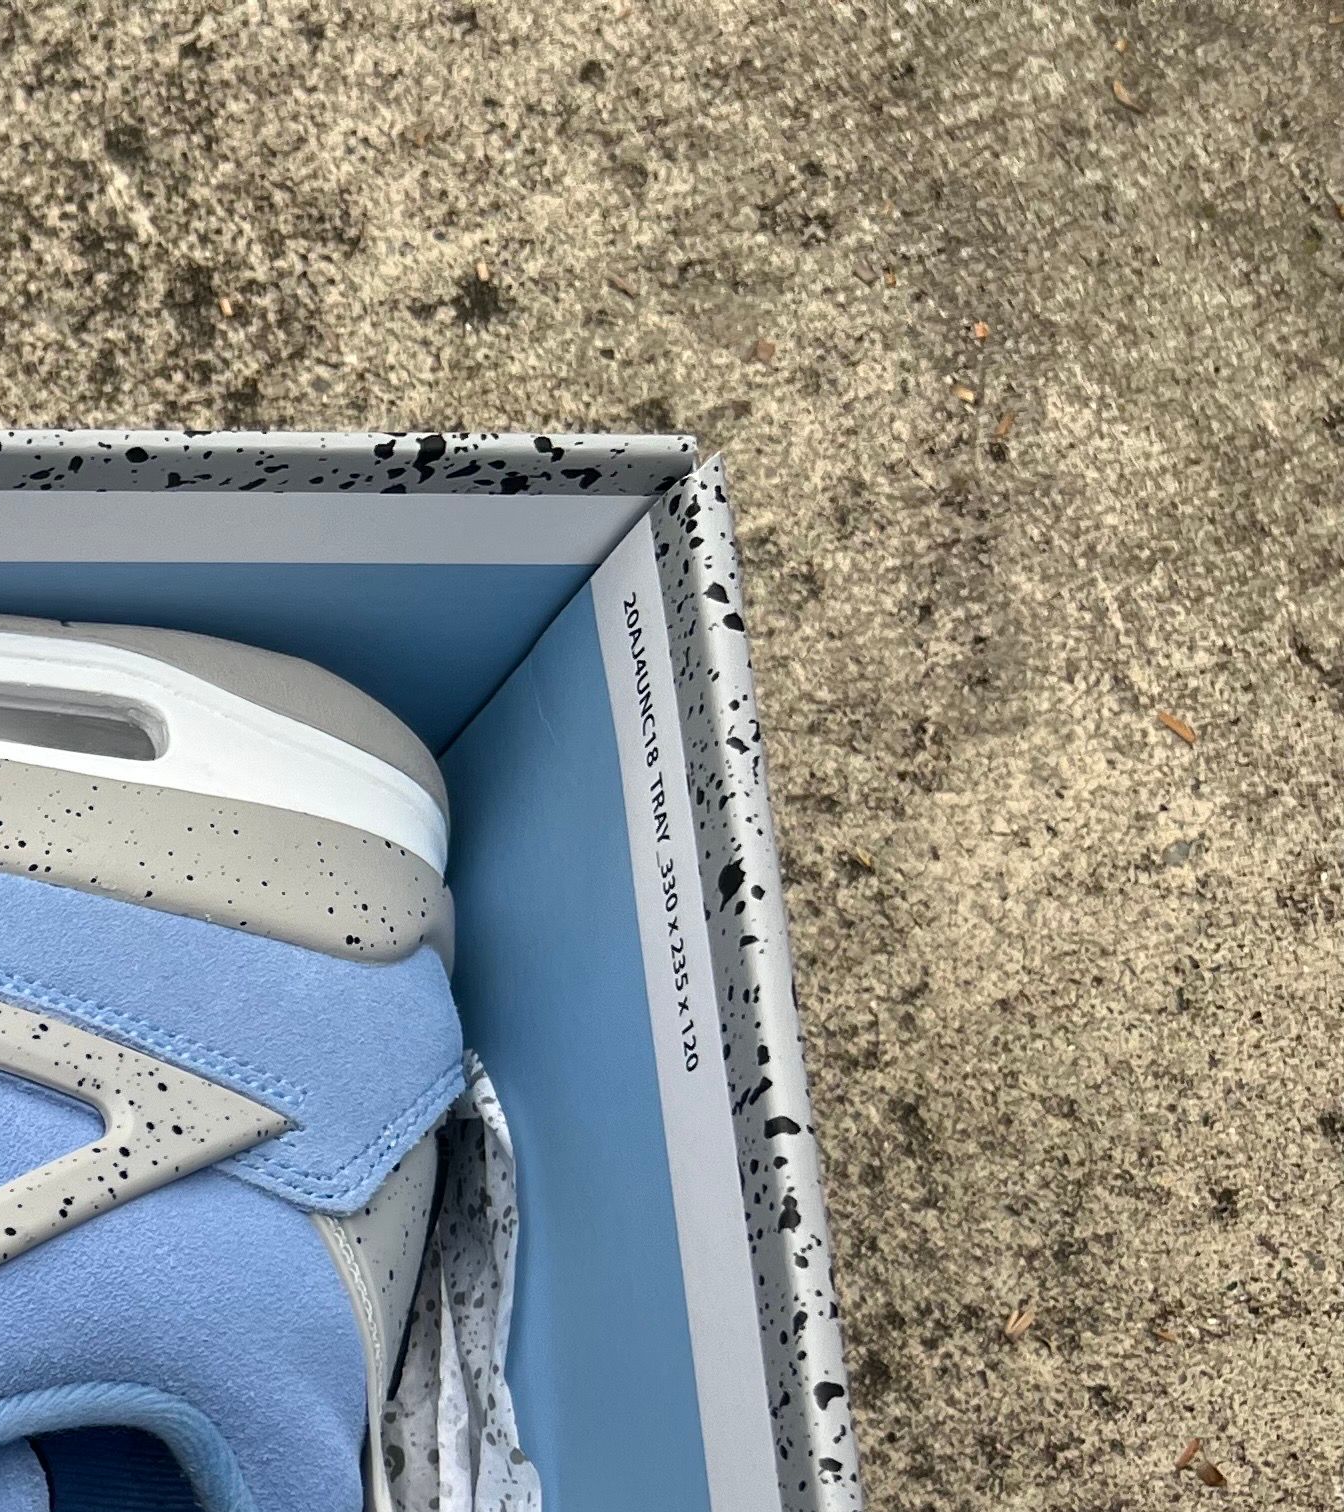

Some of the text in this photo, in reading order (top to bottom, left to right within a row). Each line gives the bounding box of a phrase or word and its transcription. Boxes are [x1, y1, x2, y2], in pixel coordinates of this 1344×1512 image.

[623, 591, 659, 768] 20AJ4UNC18
[650, 771, 671, 843] TRAY
[667, 916, 679, 937] x
[670, 937, 689, 992] 235
[677, 996, 690, 1017] x
[681, 1019, 699, 1073] 120
